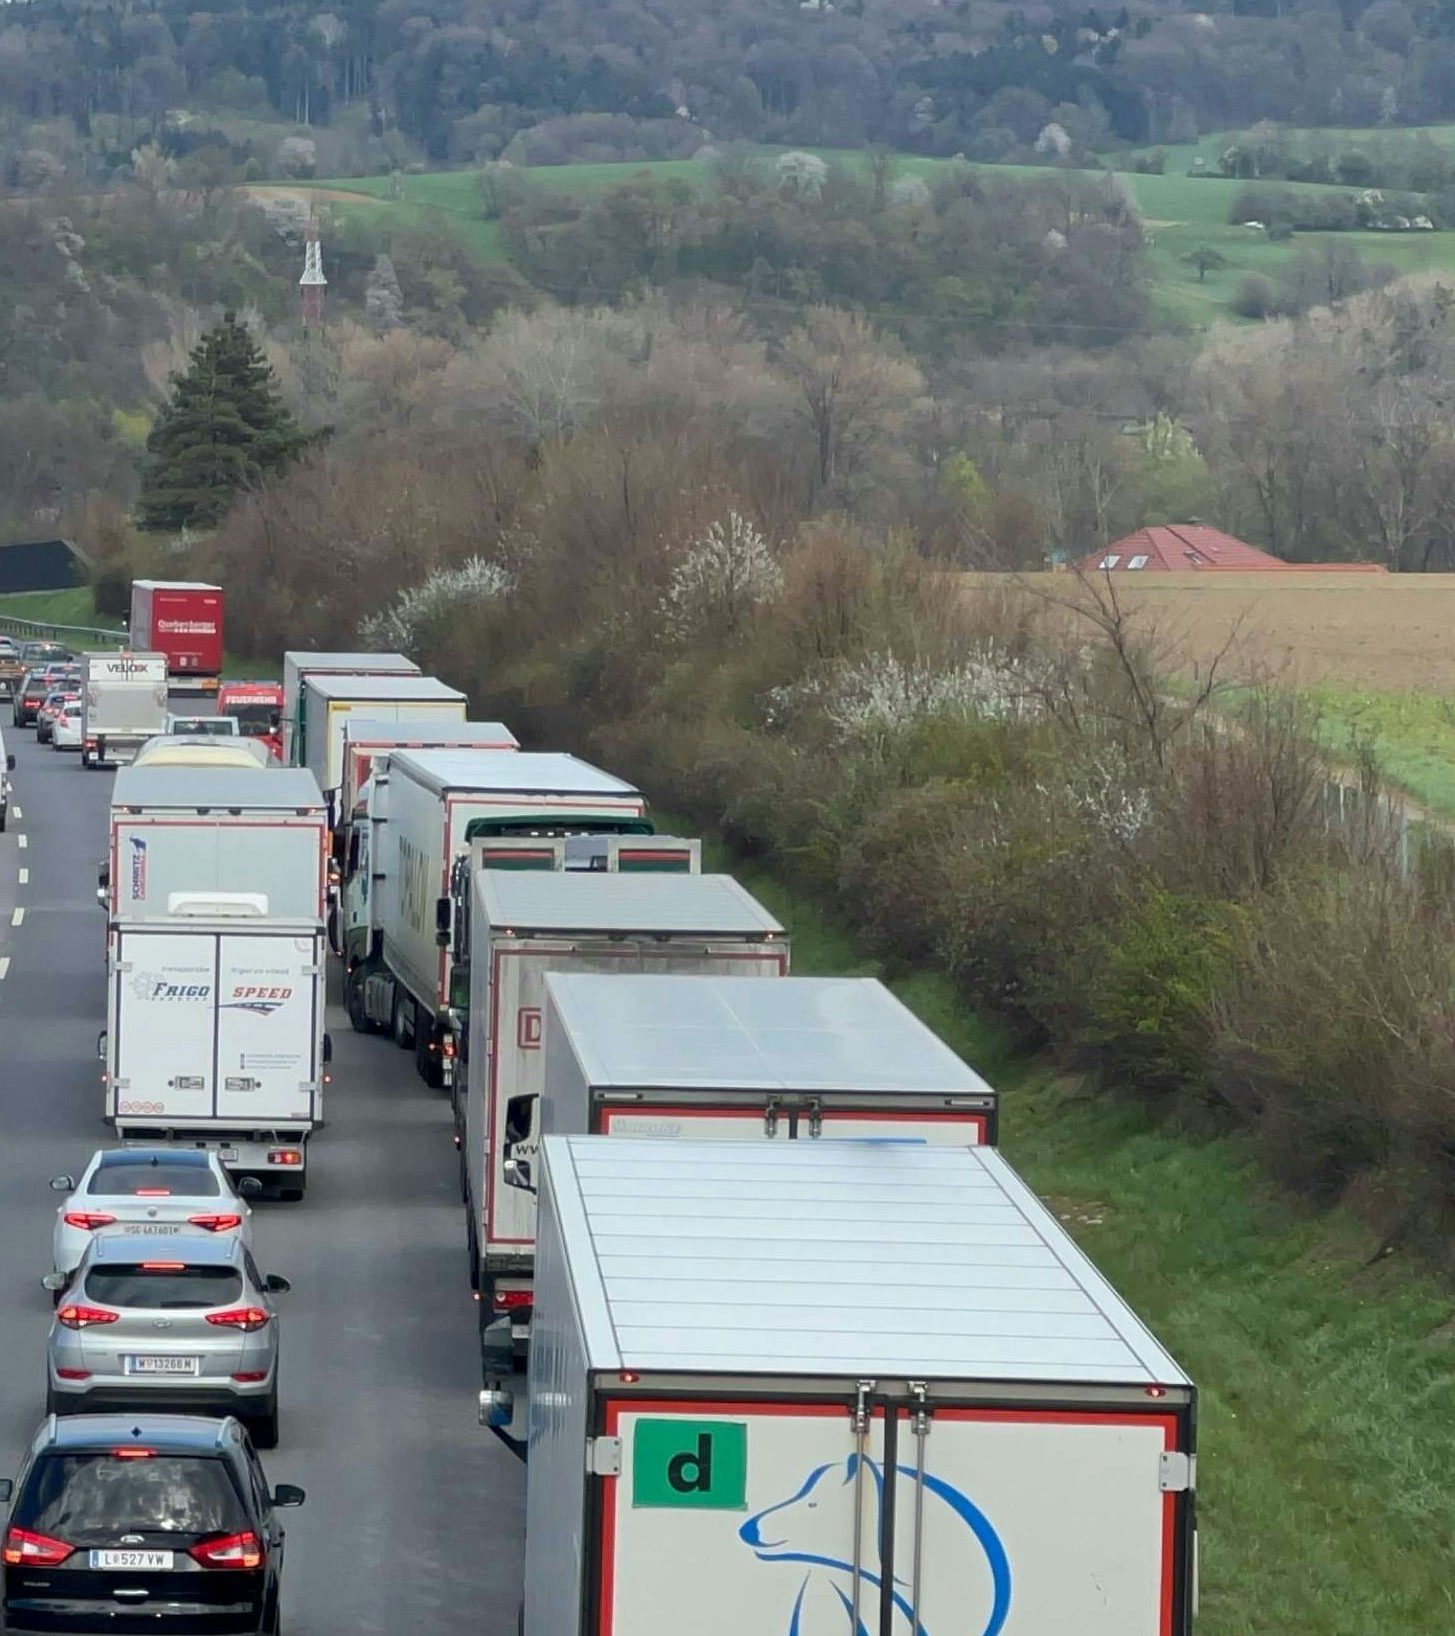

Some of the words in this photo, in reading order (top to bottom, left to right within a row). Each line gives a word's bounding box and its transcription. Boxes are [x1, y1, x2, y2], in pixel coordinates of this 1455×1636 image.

[153, 982, 211, 997] FRIGO
[232, 986, 292, 999] SPEED
[667, 1433, 712, 1493] d
